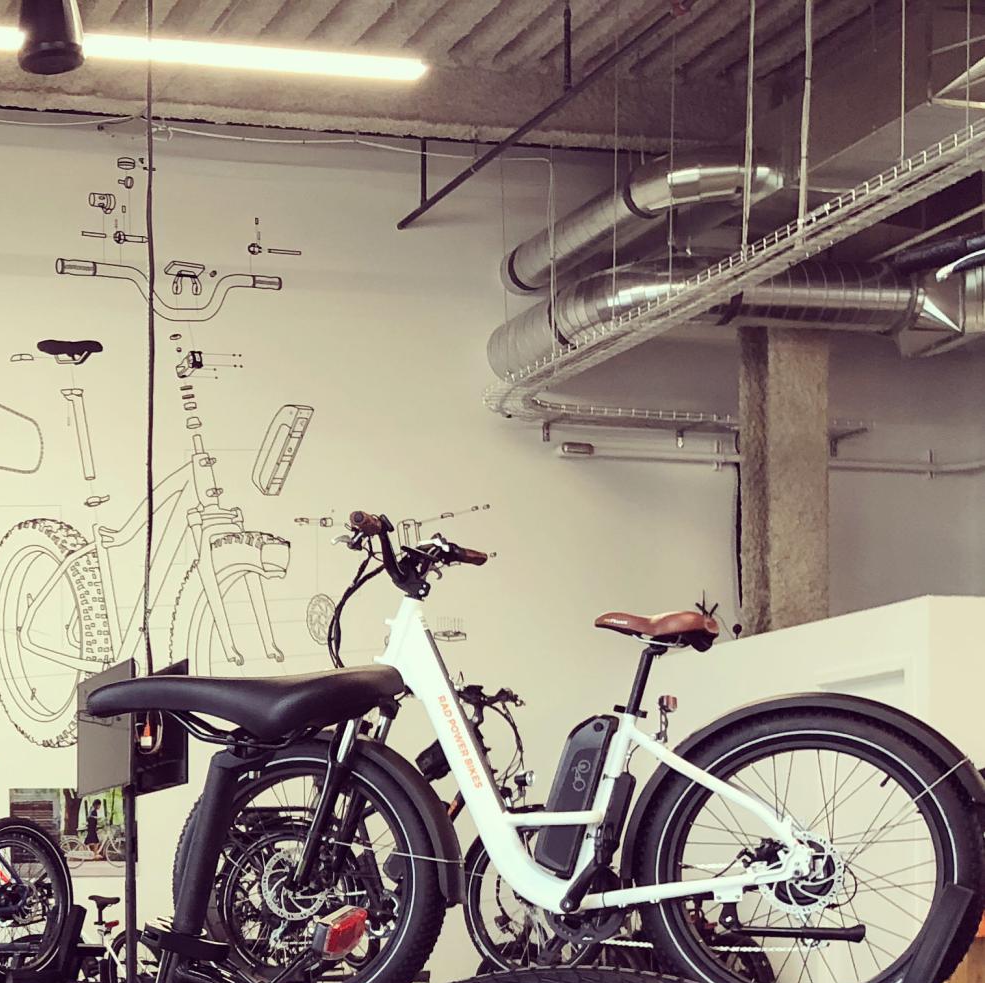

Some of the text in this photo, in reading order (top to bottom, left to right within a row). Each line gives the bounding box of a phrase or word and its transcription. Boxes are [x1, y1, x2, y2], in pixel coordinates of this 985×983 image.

[438, 695, 483, 789] RAD POWER BIKES
